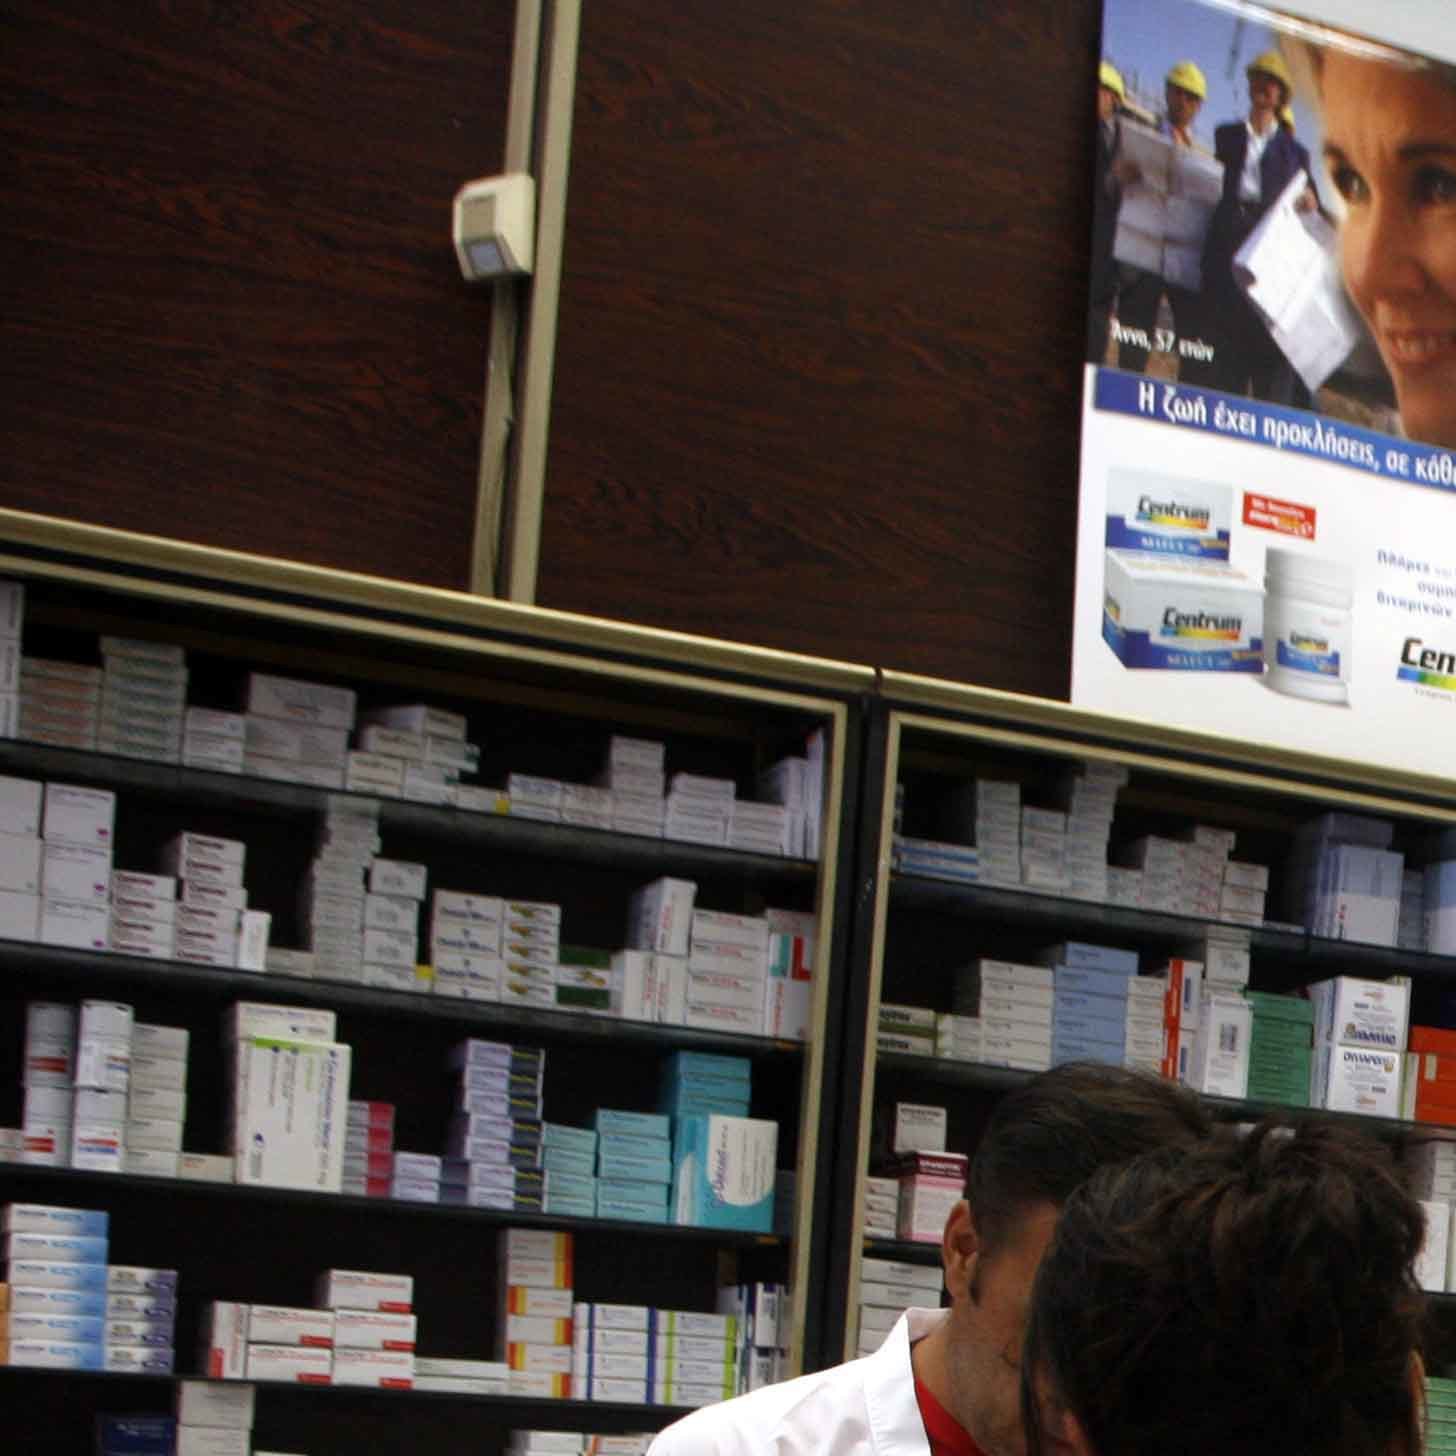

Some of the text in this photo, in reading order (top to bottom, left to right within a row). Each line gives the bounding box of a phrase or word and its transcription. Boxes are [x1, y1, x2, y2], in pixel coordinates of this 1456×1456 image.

[1154, 327, 1176, 352] 57
[1138, 381, 1155, 414] Η
[1162, 384, 1208, 425] ζωή
[1213, 401, 1257, 436] έχει
[1263, 416, 1381, 472] προκλήσεις,
[1385, 449, 1410, 477] σε
[1136, 495, 1211, 522] Centrum
[1162, 606, 1242, 632] Centrum
